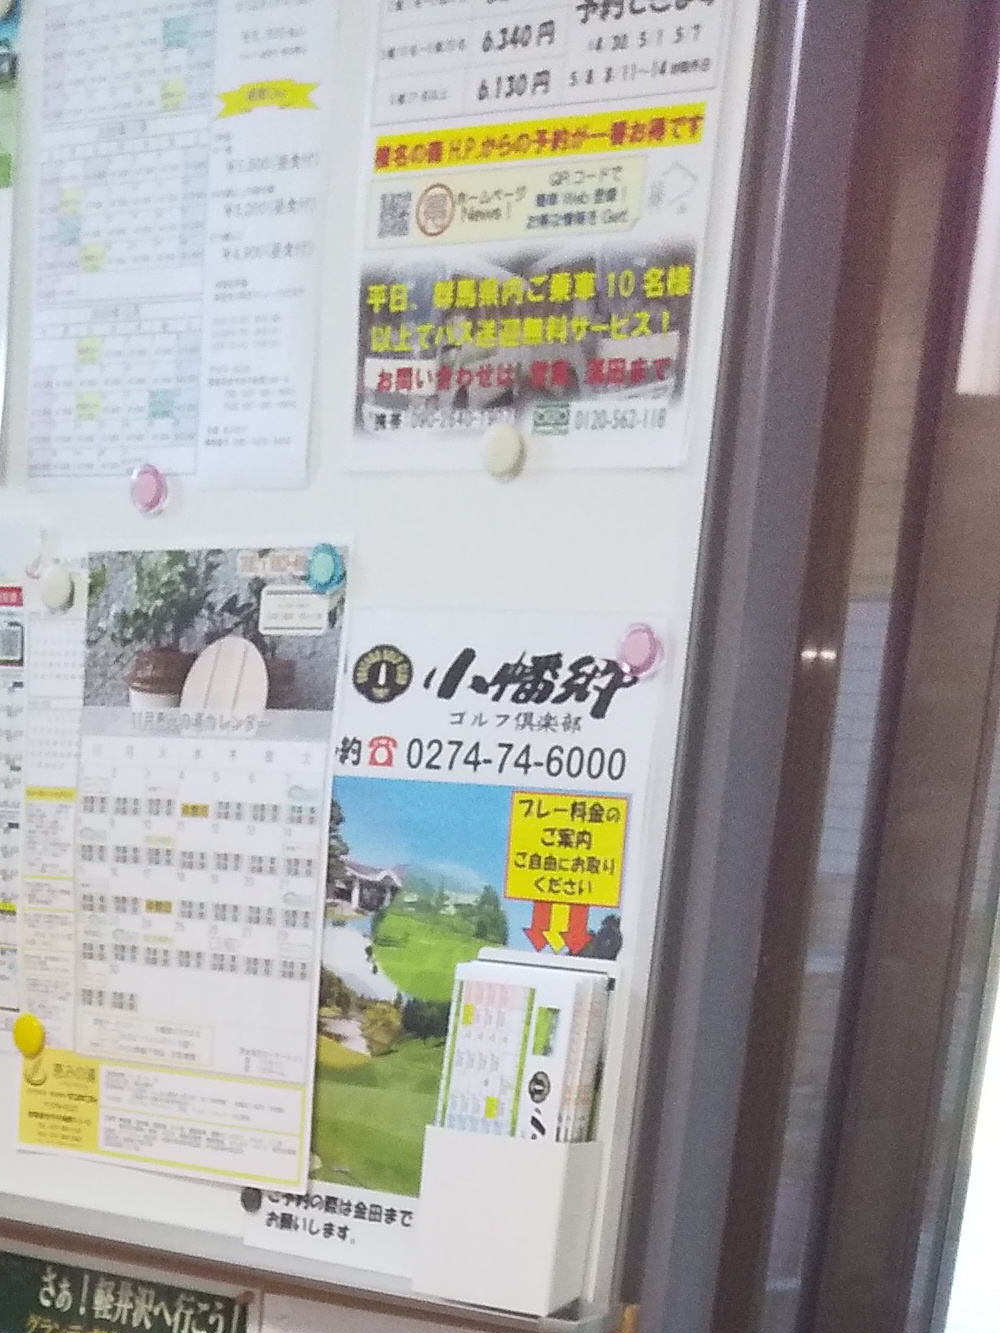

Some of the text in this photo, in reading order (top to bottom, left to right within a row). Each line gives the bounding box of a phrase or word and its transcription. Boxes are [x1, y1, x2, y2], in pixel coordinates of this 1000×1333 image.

[449, 711, 583, 733] ゴルフ倶楽部
[406, 738, 627, 781] 0274-74-6000
[518, 799, 621, 823] プレー料金の
[540, 827, 593, 850] ご案内
[514, 852, 616, 876] ご自由にお取り
[533, 876, 593, 896] ください
[265, 1211, 356, 1245] お願いします。
